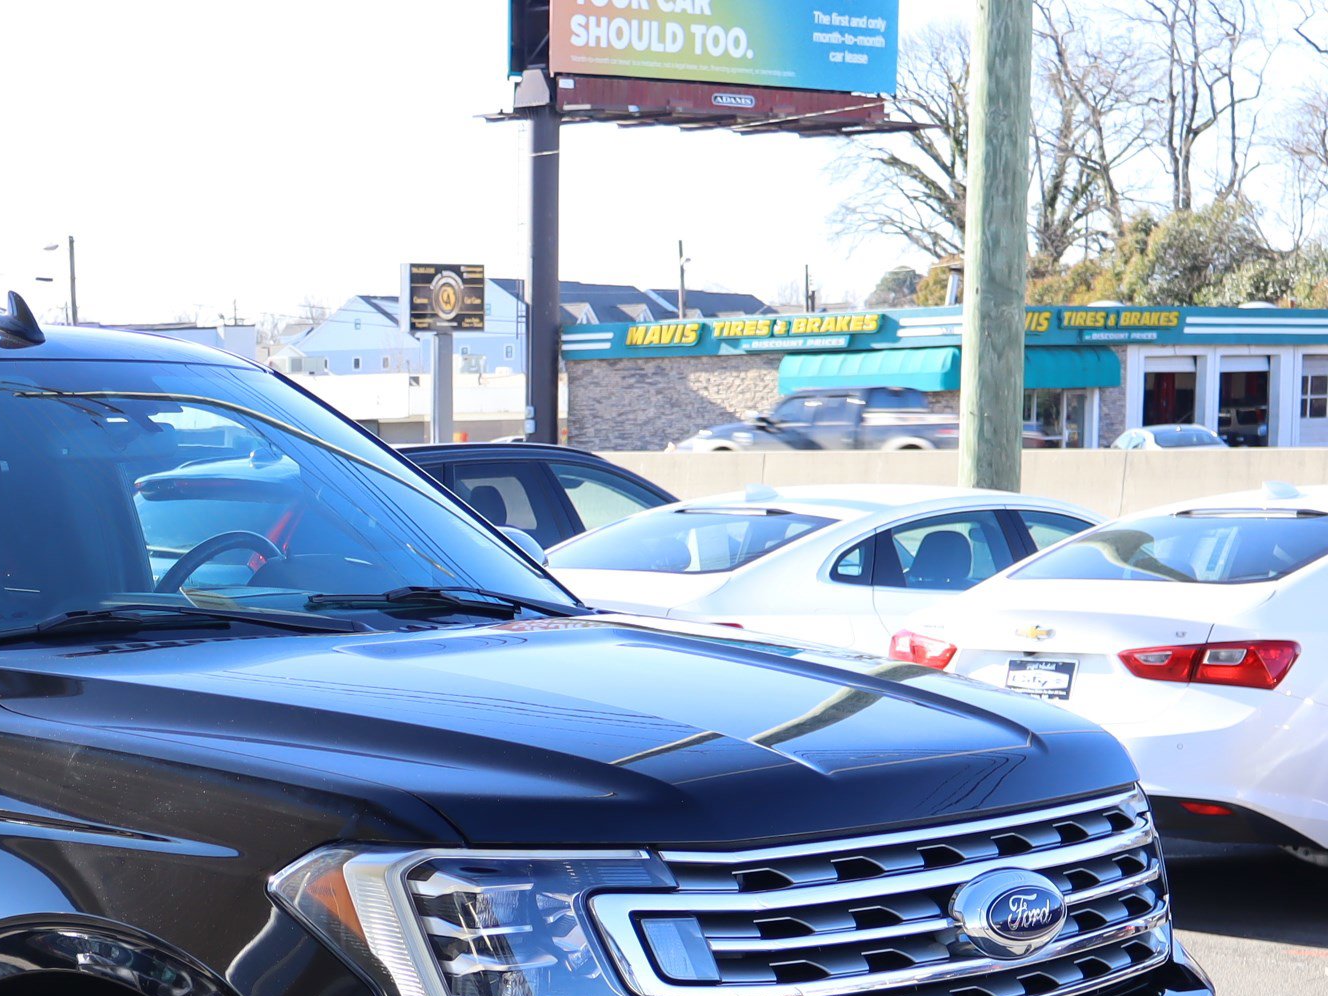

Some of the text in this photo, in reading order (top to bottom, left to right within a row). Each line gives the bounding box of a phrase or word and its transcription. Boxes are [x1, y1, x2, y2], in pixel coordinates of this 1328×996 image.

[813, 10, 886, 32] The first and only
[570, 14, 754, 59] SHOULD TOO.
[812, 31, 885, 48] month-to-month
[829, 50, 869, 64] car lease
[714, 95, 753, 105] ADAMS
[1063, 311, 1106, 327] TIRES
[1119, 311, 1180, 327] BRAKES
[625, 322, 701, 346] MAVIS
[713, 319, 771, 337] TIRES
[791, 314, 880, 334] BRAKES
[751, 339, 804, 349] DISCOUNT
[1008, 893, 1052, 930] Ford
